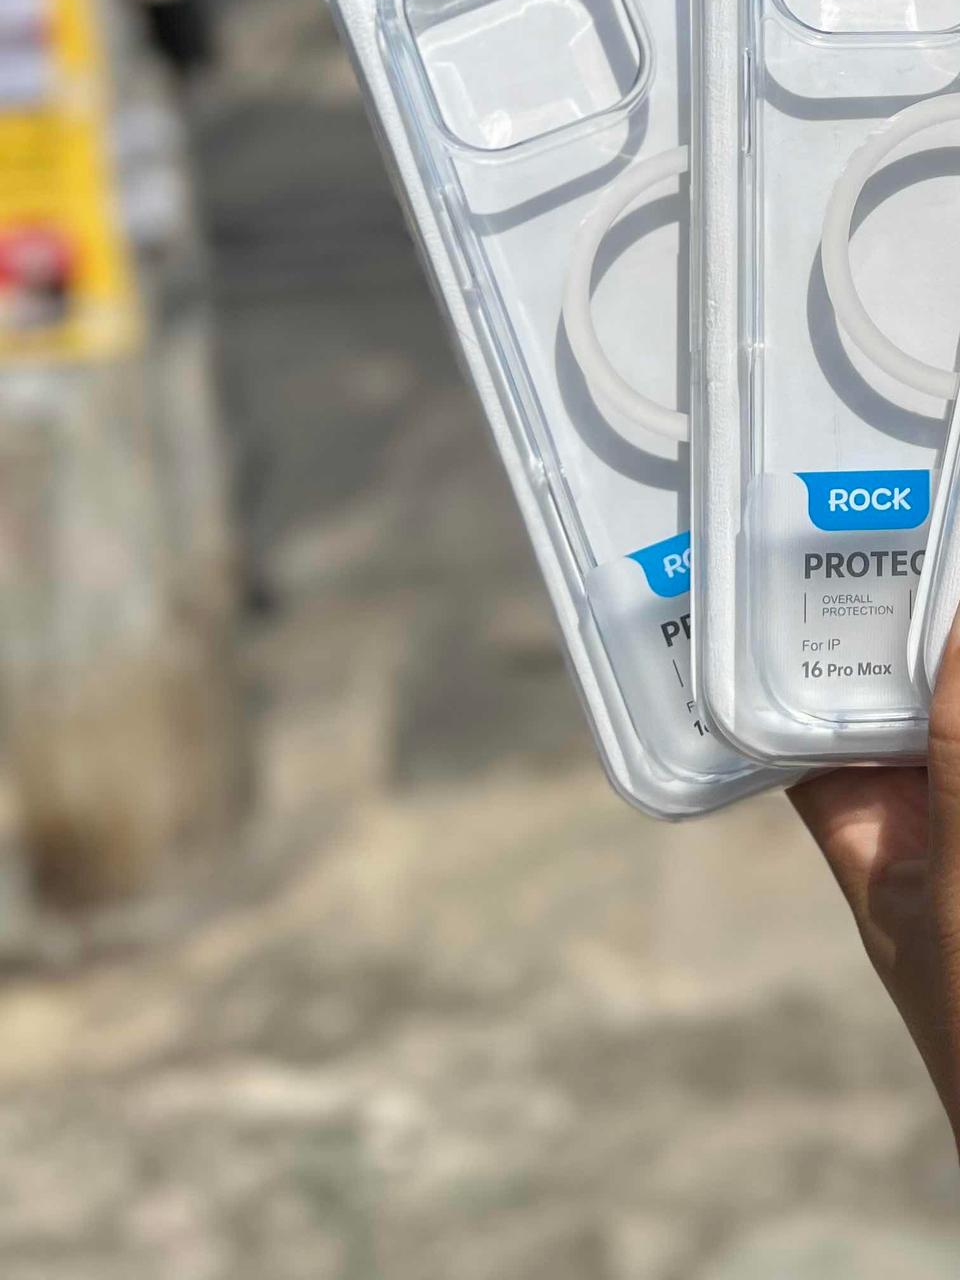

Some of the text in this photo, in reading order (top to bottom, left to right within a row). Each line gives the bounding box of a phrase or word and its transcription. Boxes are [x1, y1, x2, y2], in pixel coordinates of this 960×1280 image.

[828, 487, 911, 512] ROCK
[822, 594, 873, 604] OVERALL
[822, 605, 894, 617] PROTECTION
[802, 638, 841, 652] For IP
[801, 660, 892, 678] 16 Pro Max
